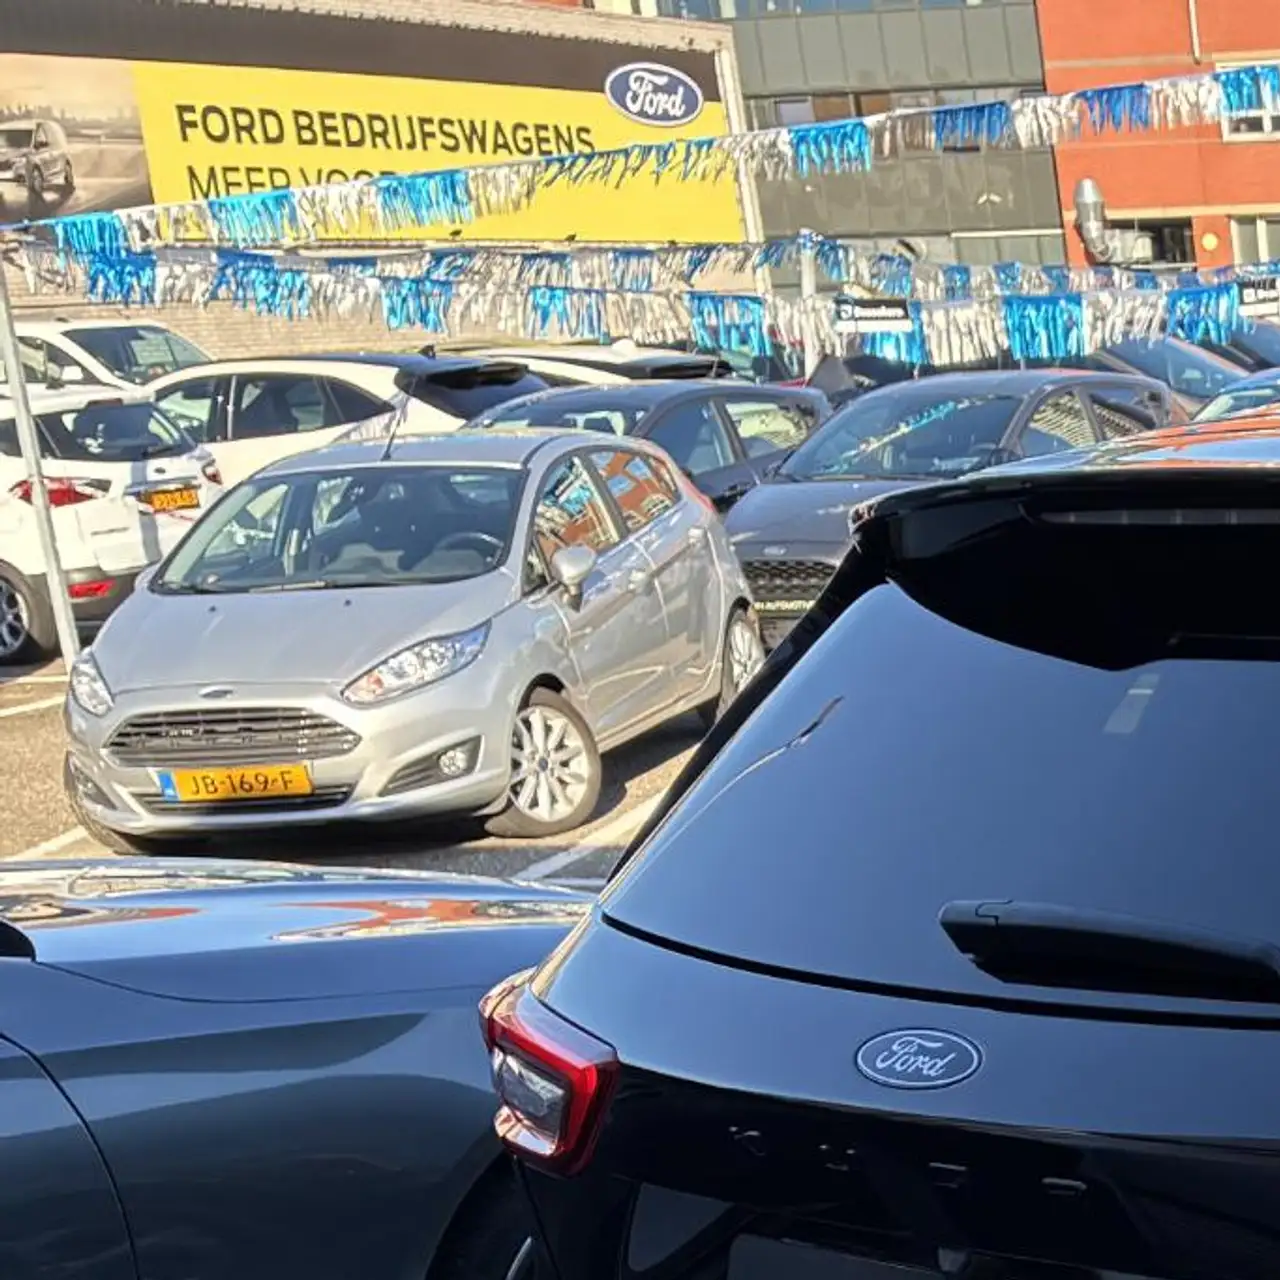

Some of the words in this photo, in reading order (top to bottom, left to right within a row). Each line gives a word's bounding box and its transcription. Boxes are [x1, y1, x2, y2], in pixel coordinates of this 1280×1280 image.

[625, 70, 686, 118] Ford
[175, 103, 285, 145] FORD
[290, 109, 596, 156] BEDRIJFSWAGENS
[191, 770, 293, 796] JB-169-F
[875, 1036, 957, 1077] Ford
